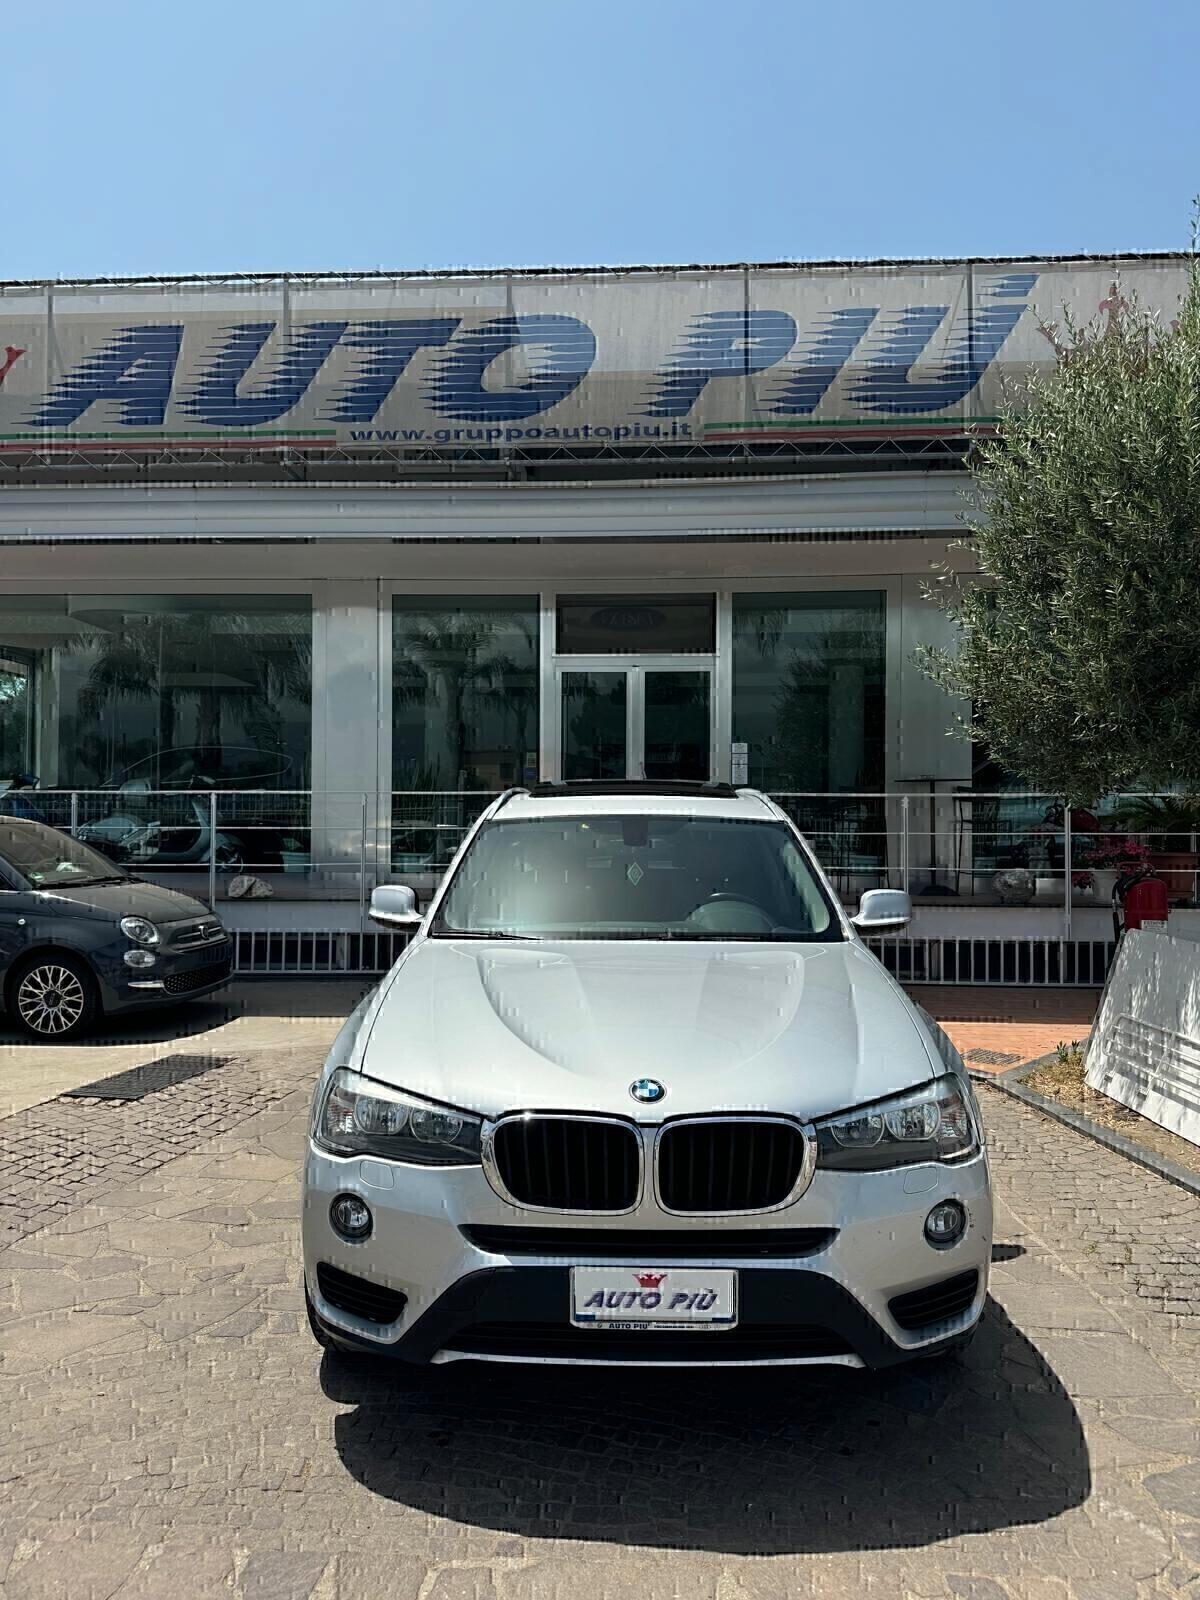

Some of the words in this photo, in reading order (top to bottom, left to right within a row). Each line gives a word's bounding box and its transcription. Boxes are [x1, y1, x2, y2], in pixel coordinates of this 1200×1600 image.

[10, 314, 598, 427] AUTO
[627, 274, 1040, 418] PIÙ
[349, 421, 692, 442] www.gruppoautopiu.it
[584, 1290, 662, 1310] AUTO
[666, 1288, 718, 1311] PIÙ
[608, 1322, 632, 1330] AUTO
